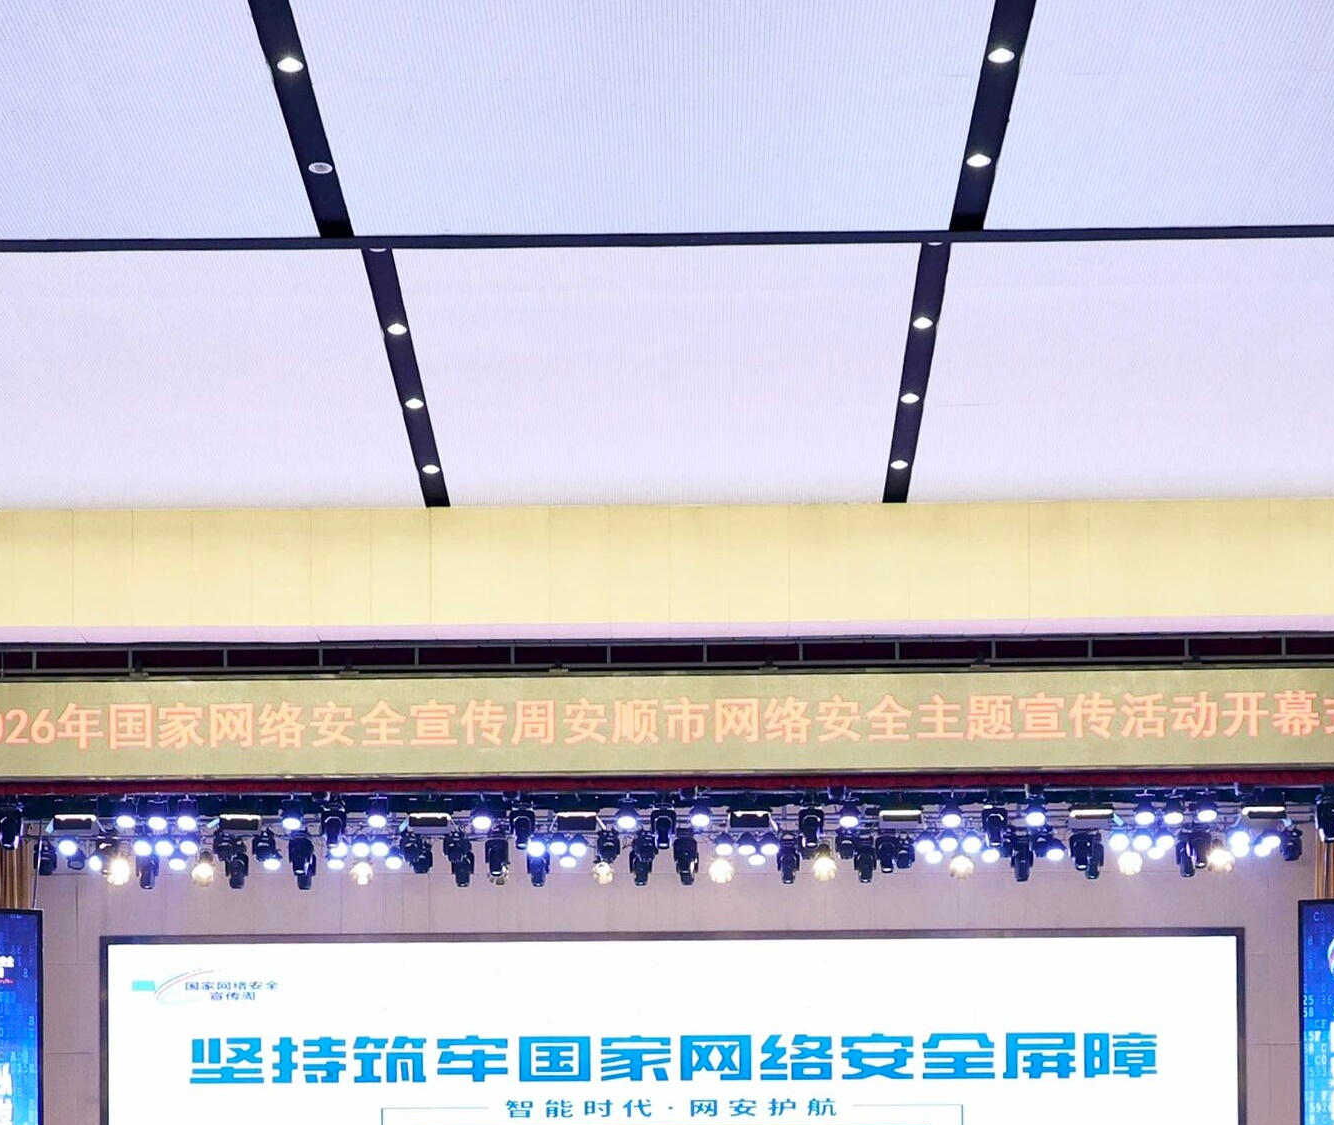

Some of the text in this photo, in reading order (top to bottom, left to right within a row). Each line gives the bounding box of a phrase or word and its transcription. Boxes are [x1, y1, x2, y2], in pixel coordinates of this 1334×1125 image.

[189, 1031, 1158, 1085] 坚持筑牢国家网络安全屏障
